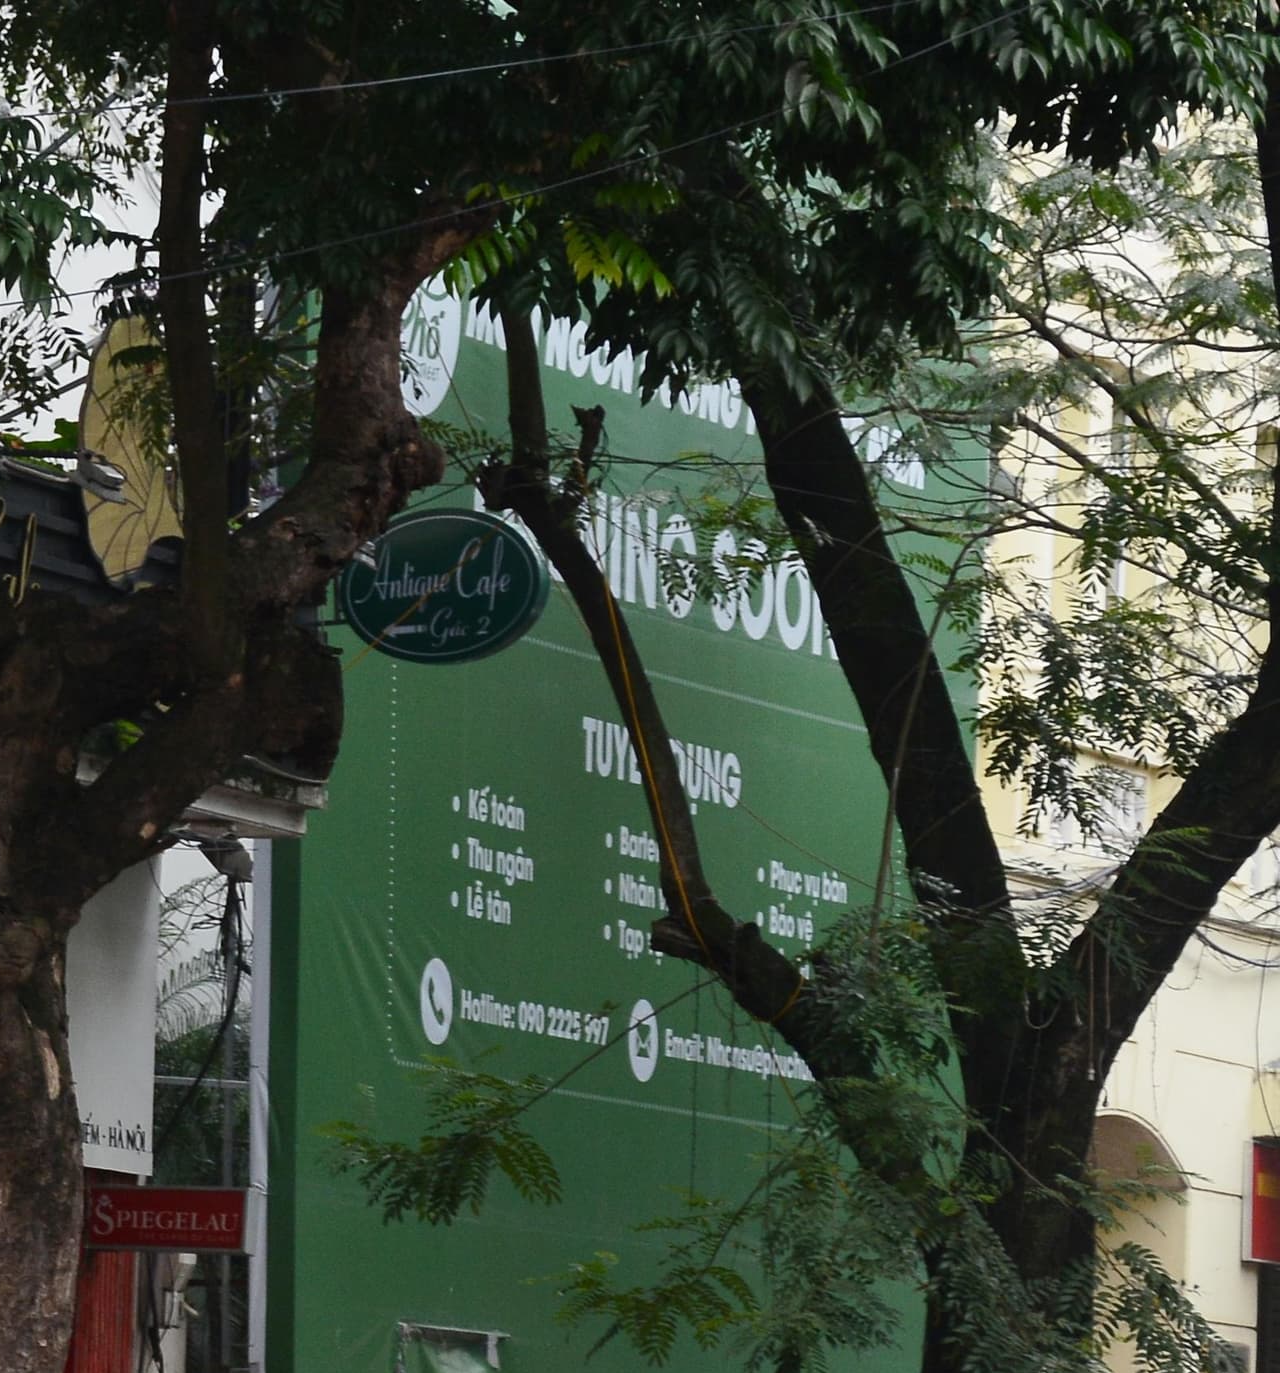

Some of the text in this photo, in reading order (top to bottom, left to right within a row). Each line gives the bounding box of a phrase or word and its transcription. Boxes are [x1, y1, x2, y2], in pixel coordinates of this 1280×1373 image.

[353, 536, 511, 612] Antique Cafe
[476, 615, 490, 635] 2
[468, 785, 525, 831] Kế toán
[467, 836, 534, 887] Thu ngân
[487, 890, 511, 925] tân
[461, 988, 516, 1029] Hotline:
[518, 1001, 545, 1035] 090
[108, 1120, 125, 1150] HÀ
[126, 1123, 147, 1153] NỘI
[93, 1195, 240, 1236] SPIEGELAU
